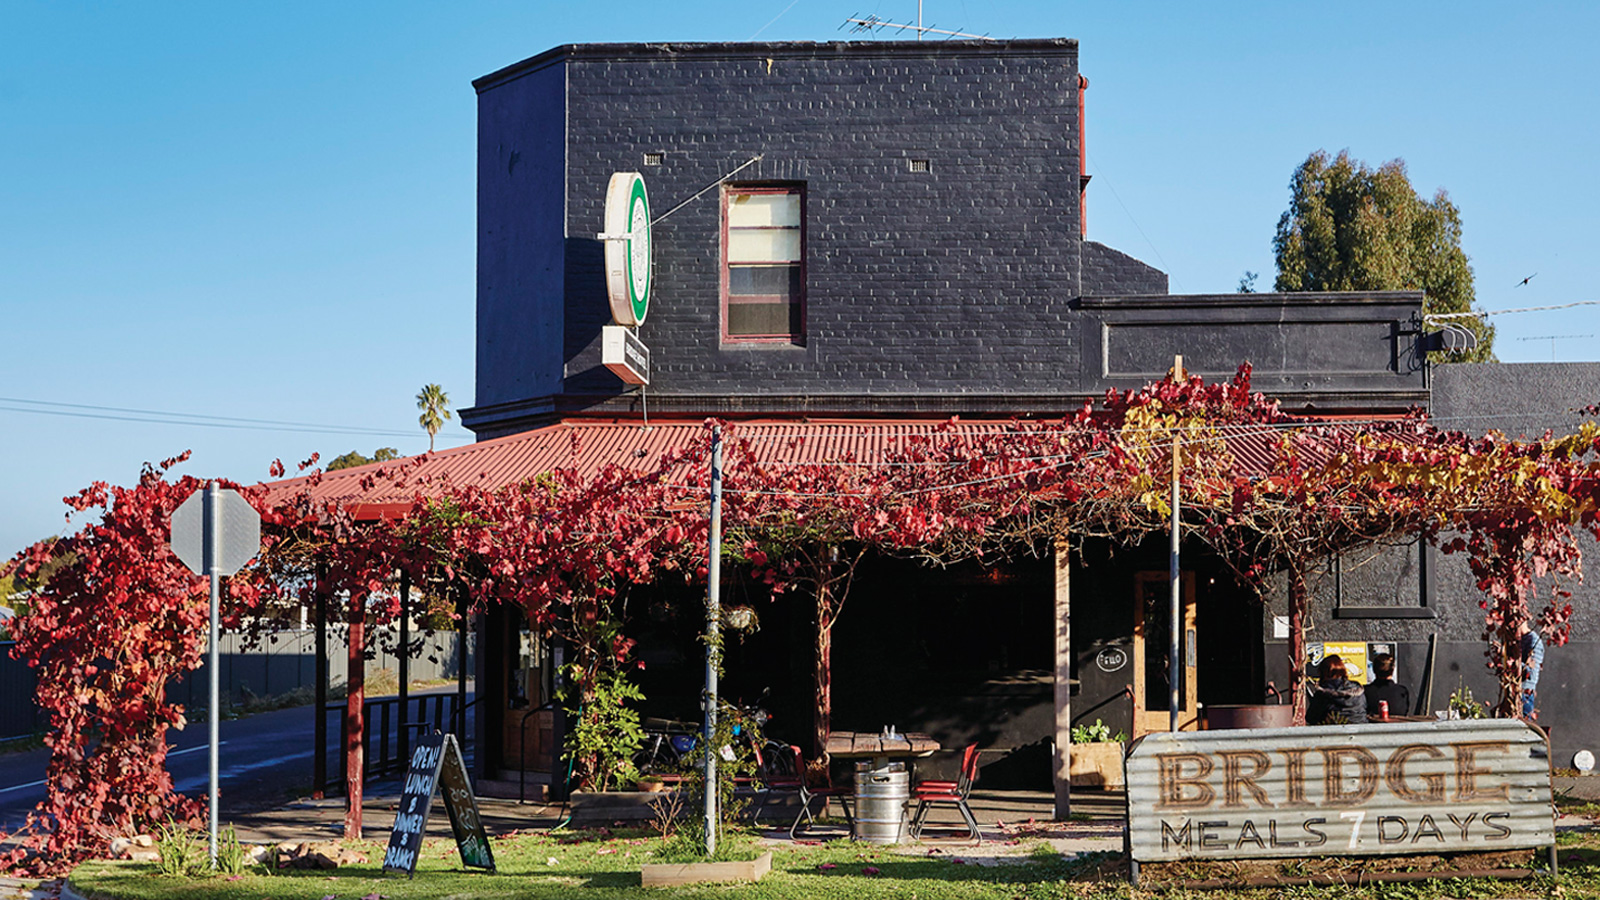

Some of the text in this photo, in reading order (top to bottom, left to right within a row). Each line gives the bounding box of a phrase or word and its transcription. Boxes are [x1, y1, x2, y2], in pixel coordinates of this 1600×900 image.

[412, 745, 441, 769] OPEN!
[404, 773, 434, 796] LUNCH
[1153, 741, 1512, 809] BRIDGE
[393, 811, 423, 834] DINNER
[1162, 811, 1512, 852] MEALS 7 DAYS
